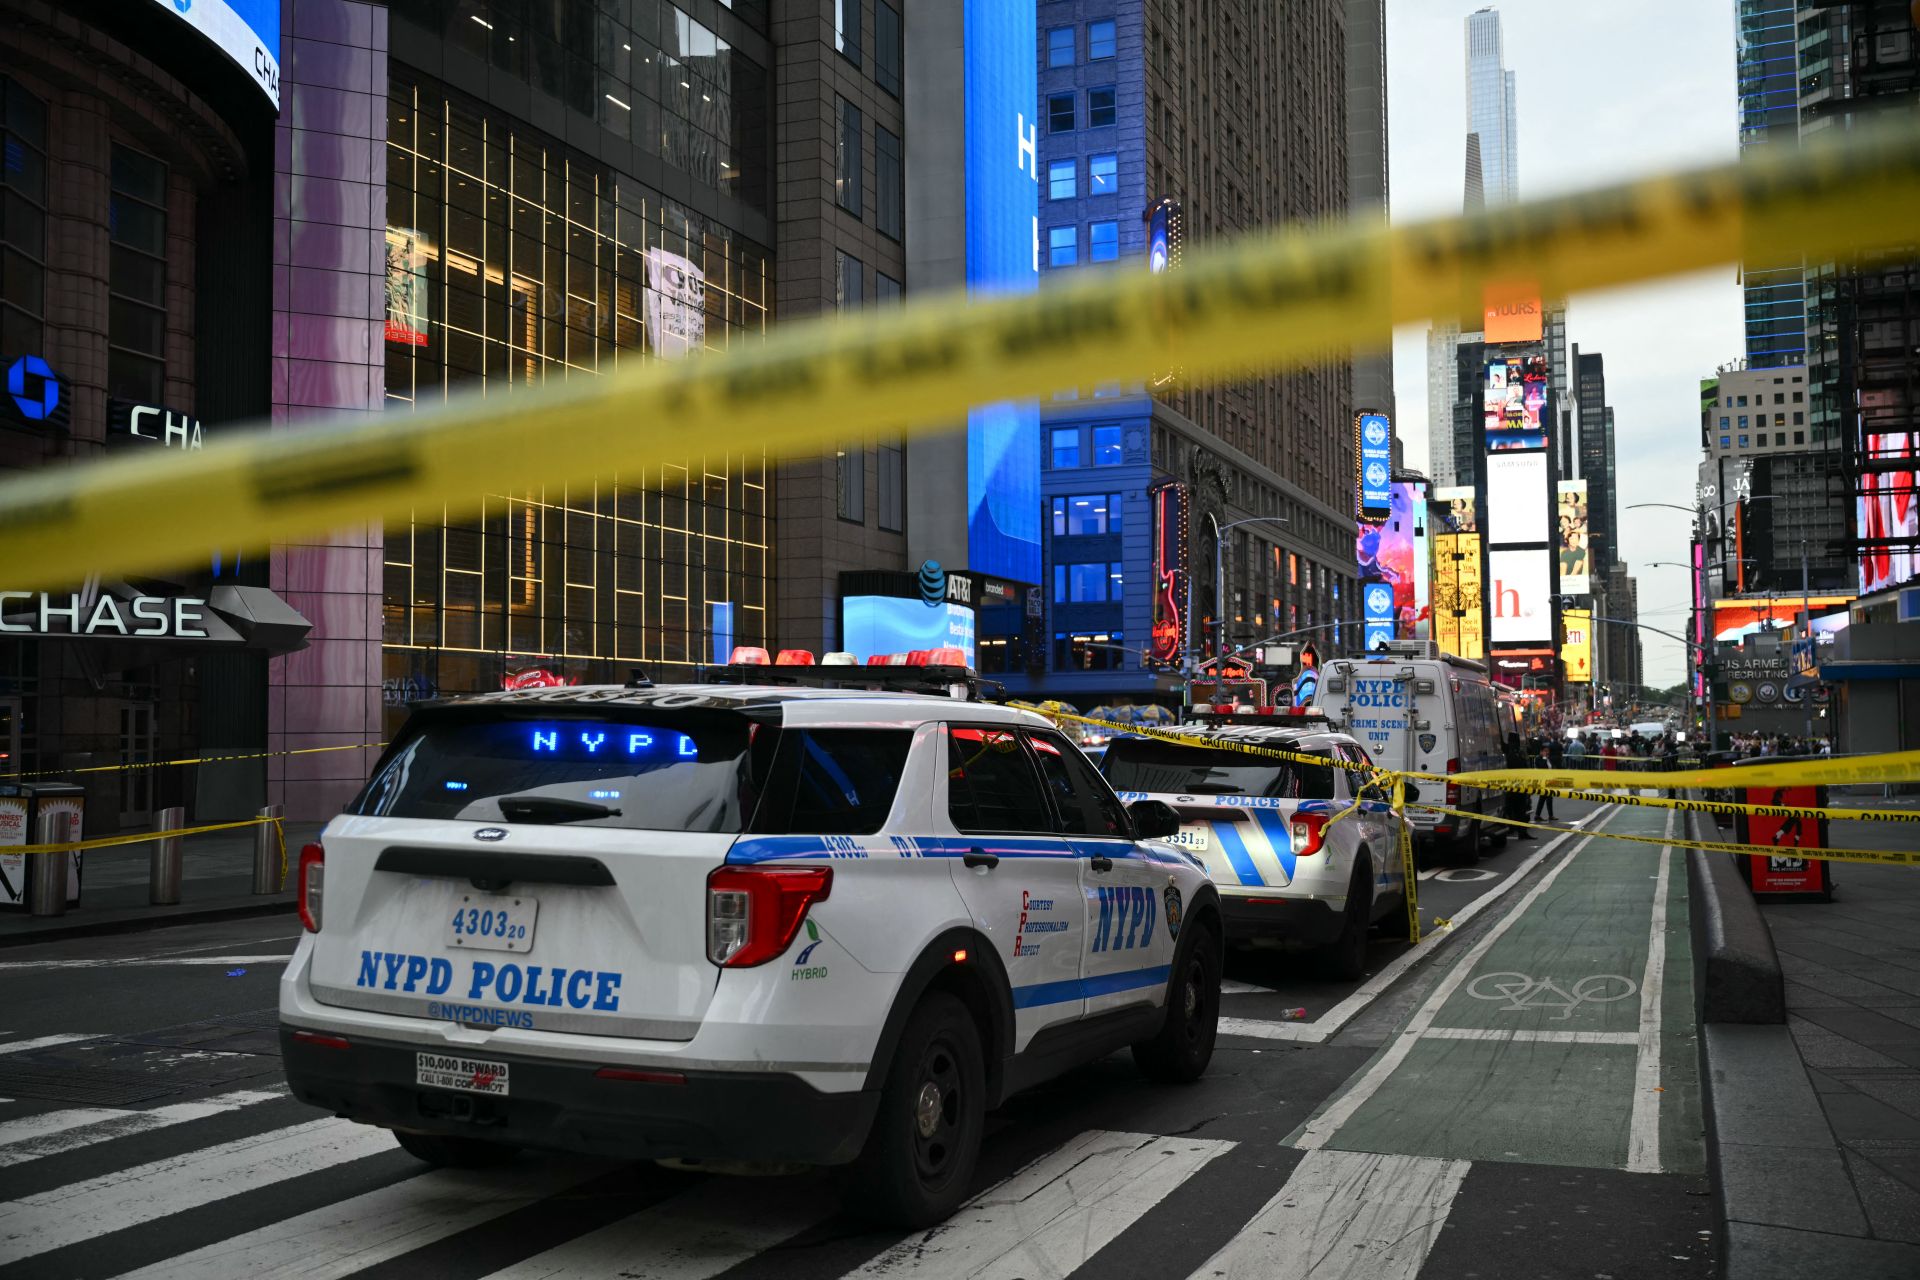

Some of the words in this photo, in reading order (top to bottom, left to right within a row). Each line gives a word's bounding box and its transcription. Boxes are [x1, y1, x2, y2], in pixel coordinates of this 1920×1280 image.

[947, 574, 972, 603] AT&T
[0, 590, 208, 638] CHASE
[1351, 720, 1377, 729] CRIME
[1368, 732, 1390, 741] UNIT
[1214, 795, 1280, 808] POLICE
[1022, 890, 1053, 911] COURTESY
[1092, 886, 1156, 952] NYPD
[357, 950, 453, 995] NYPD
[468, 961, 622, 1012] POLICE
[791, 966, 828, 982] HYBRID
[427, 1002, 534, 1028] @NYPDNEWS
[418, 1055, 458, 1073] $10,000
[461, 1060, 506, 1078] REWARD
[421, 1073, 435, 1084] CALL
